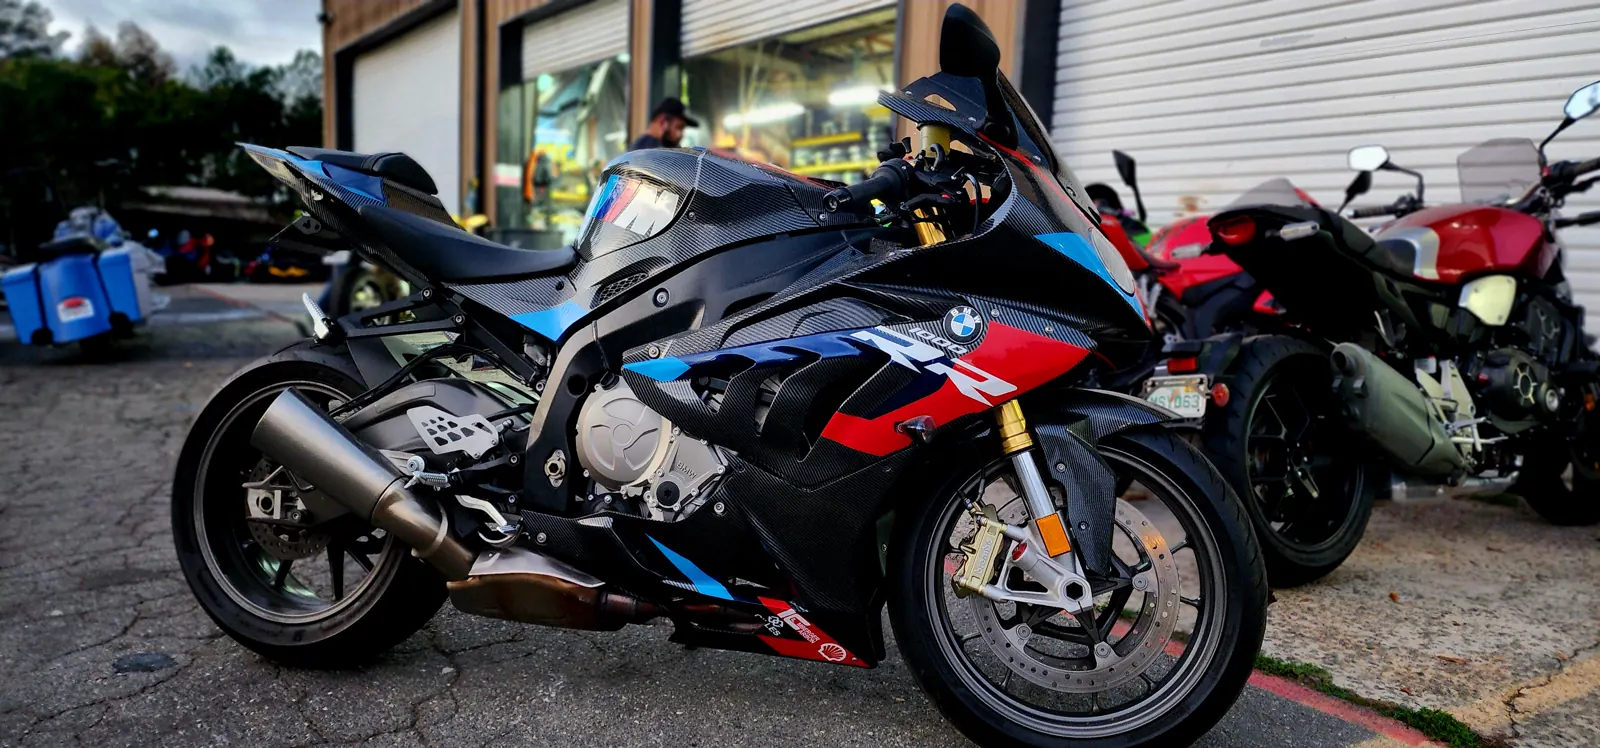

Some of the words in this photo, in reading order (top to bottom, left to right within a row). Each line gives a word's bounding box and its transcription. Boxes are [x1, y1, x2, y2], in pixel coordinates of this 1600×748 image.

[950, 307, 981, 324] BMW
[909, 327, 968, 355] 1000
[677, 460, 698, 479] BMW
